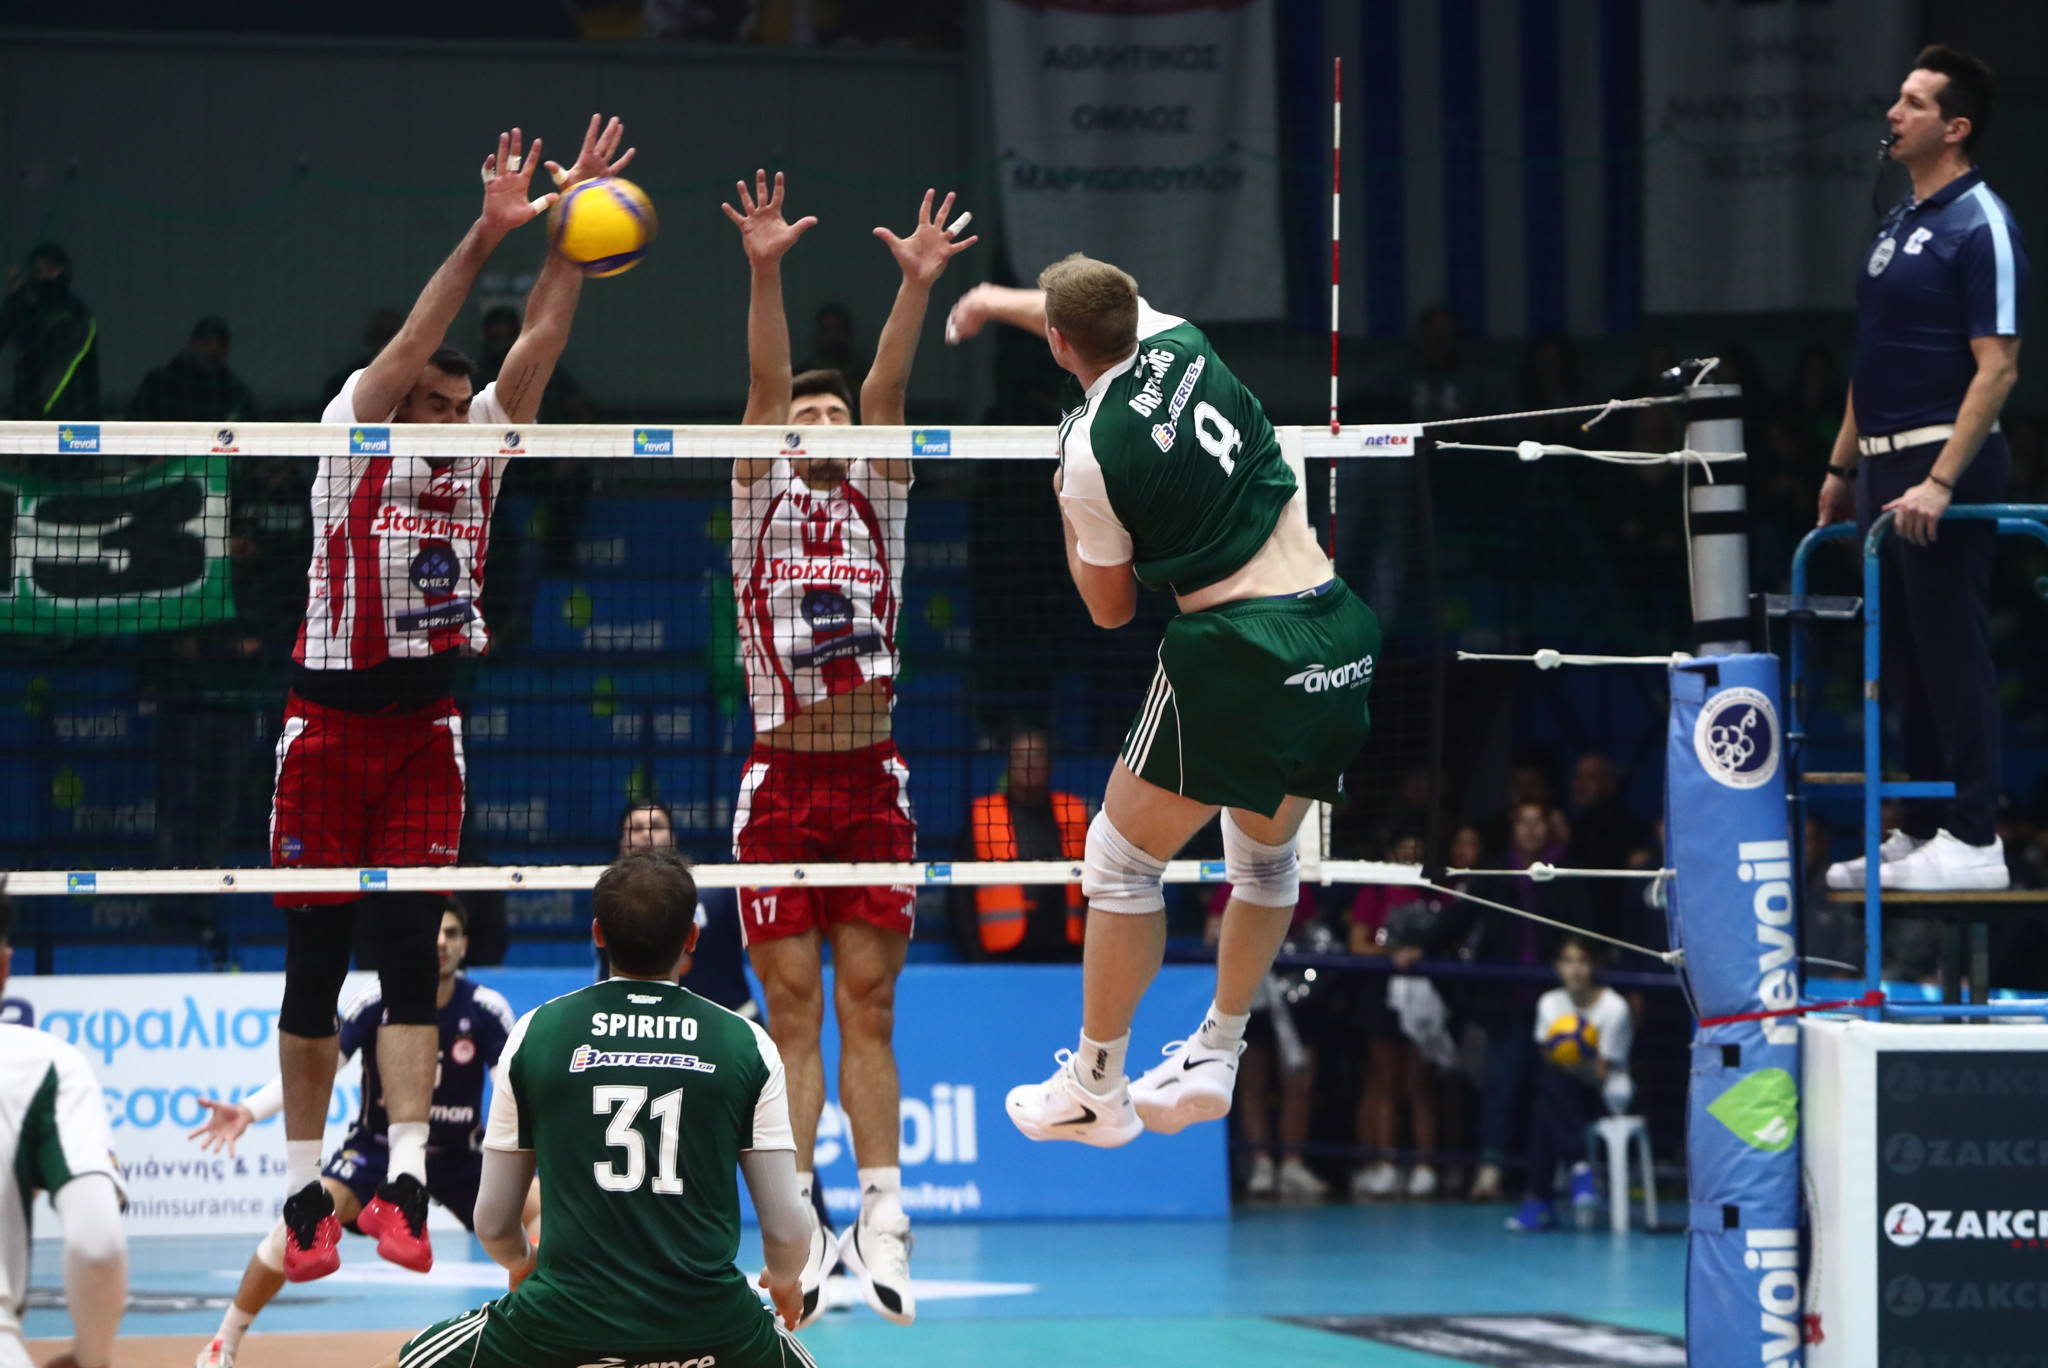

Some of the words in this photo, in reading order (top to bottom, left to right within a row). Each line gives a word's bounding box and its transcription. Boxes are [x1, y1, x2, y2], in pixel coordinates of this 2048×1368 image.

[69, 438, 97, 450] revoil
[360, 439, 387, 451] revoil
[643, 441, 671, 452] revoil
[922, 442, 948, 453] revoil
[1365, 434, 1408, 446] netex
[376, 505, 481, 541] Stoixima
[1303, 654, 1373, 694] avance
[751, 895, 777, 926] 17
[1737, 840, 1800, 1046] revoil
[591, 1012, 698, 1042] SPIRITO
[592, 1084, 684, 1196] 31
[120, 1156, 224, 1182] γιάννης
